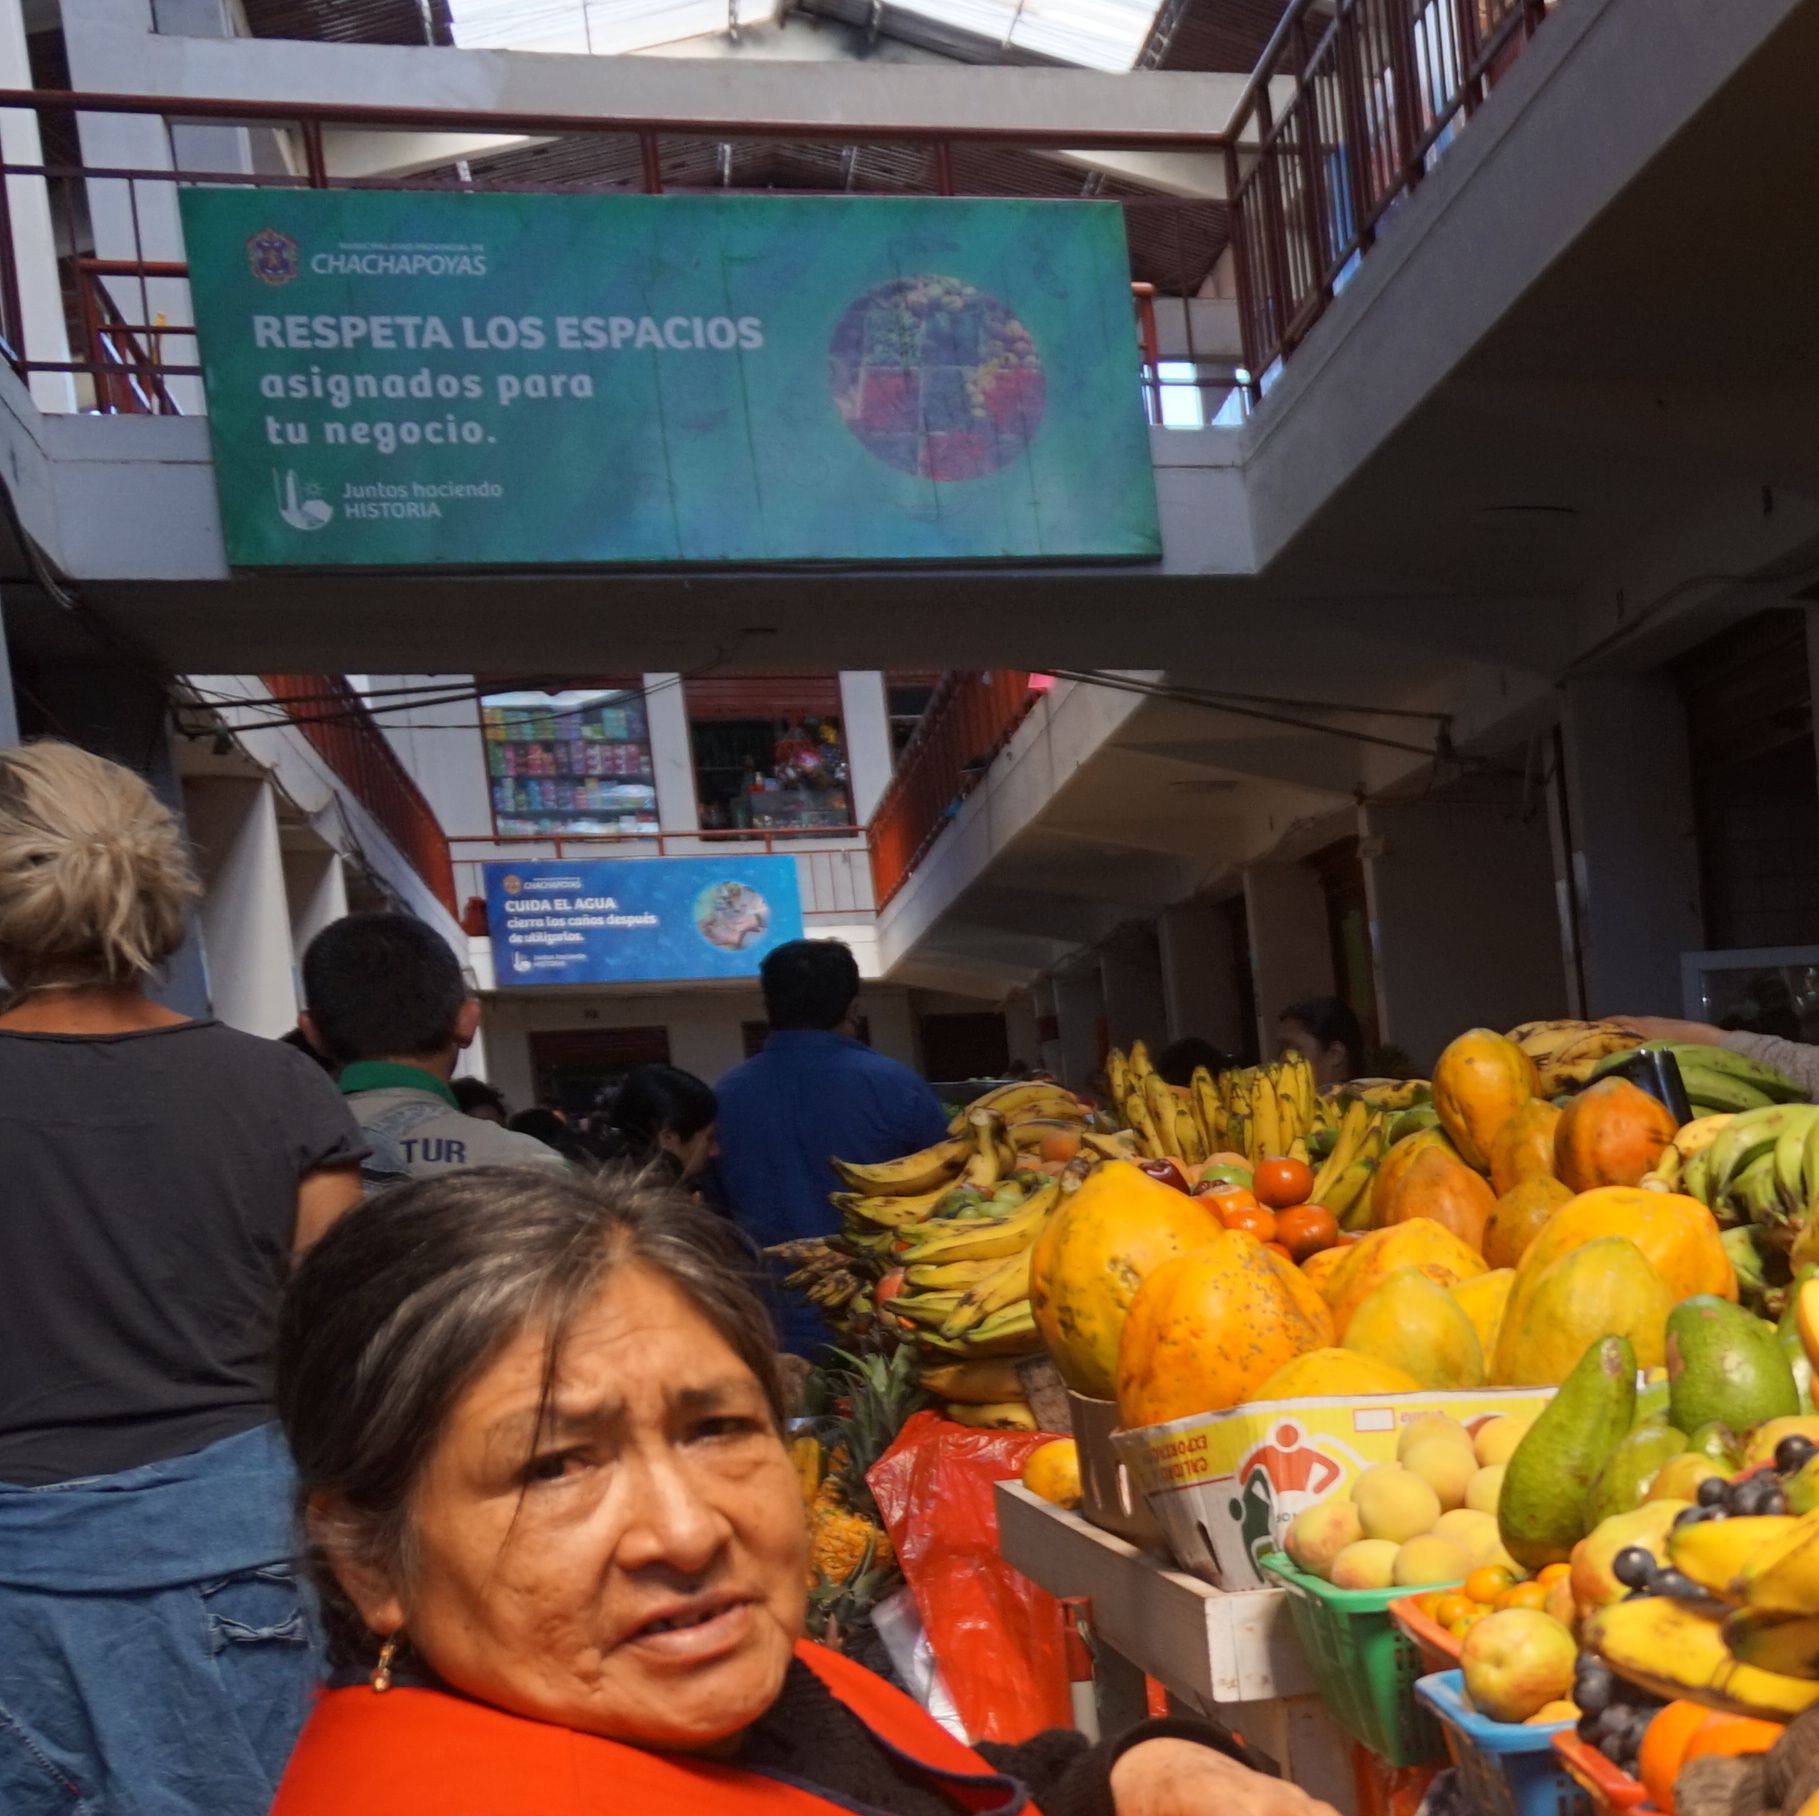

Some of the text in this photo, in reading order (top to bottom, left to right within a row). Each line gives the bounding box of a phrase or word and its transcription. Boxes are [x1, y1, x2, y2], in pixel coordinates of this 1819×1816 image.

[310, 253, 487, 276] CHACHAPOYAS
[252, 315, 764, 350] RESPETA LOS ESPACIOS
[260, 365, 594, 409] asignados para
[266, 413, 497, 454] tu negocio.
[342, 480, 504, 500] Juntos haciendo
[343, 500, 442, 520] HISTORIA
[504, 896, 617, 913] CUIDA EL AGUA
[506, 911, 658, 930] cierra los caños después
[400, 1138, 467, 1164] TUR
